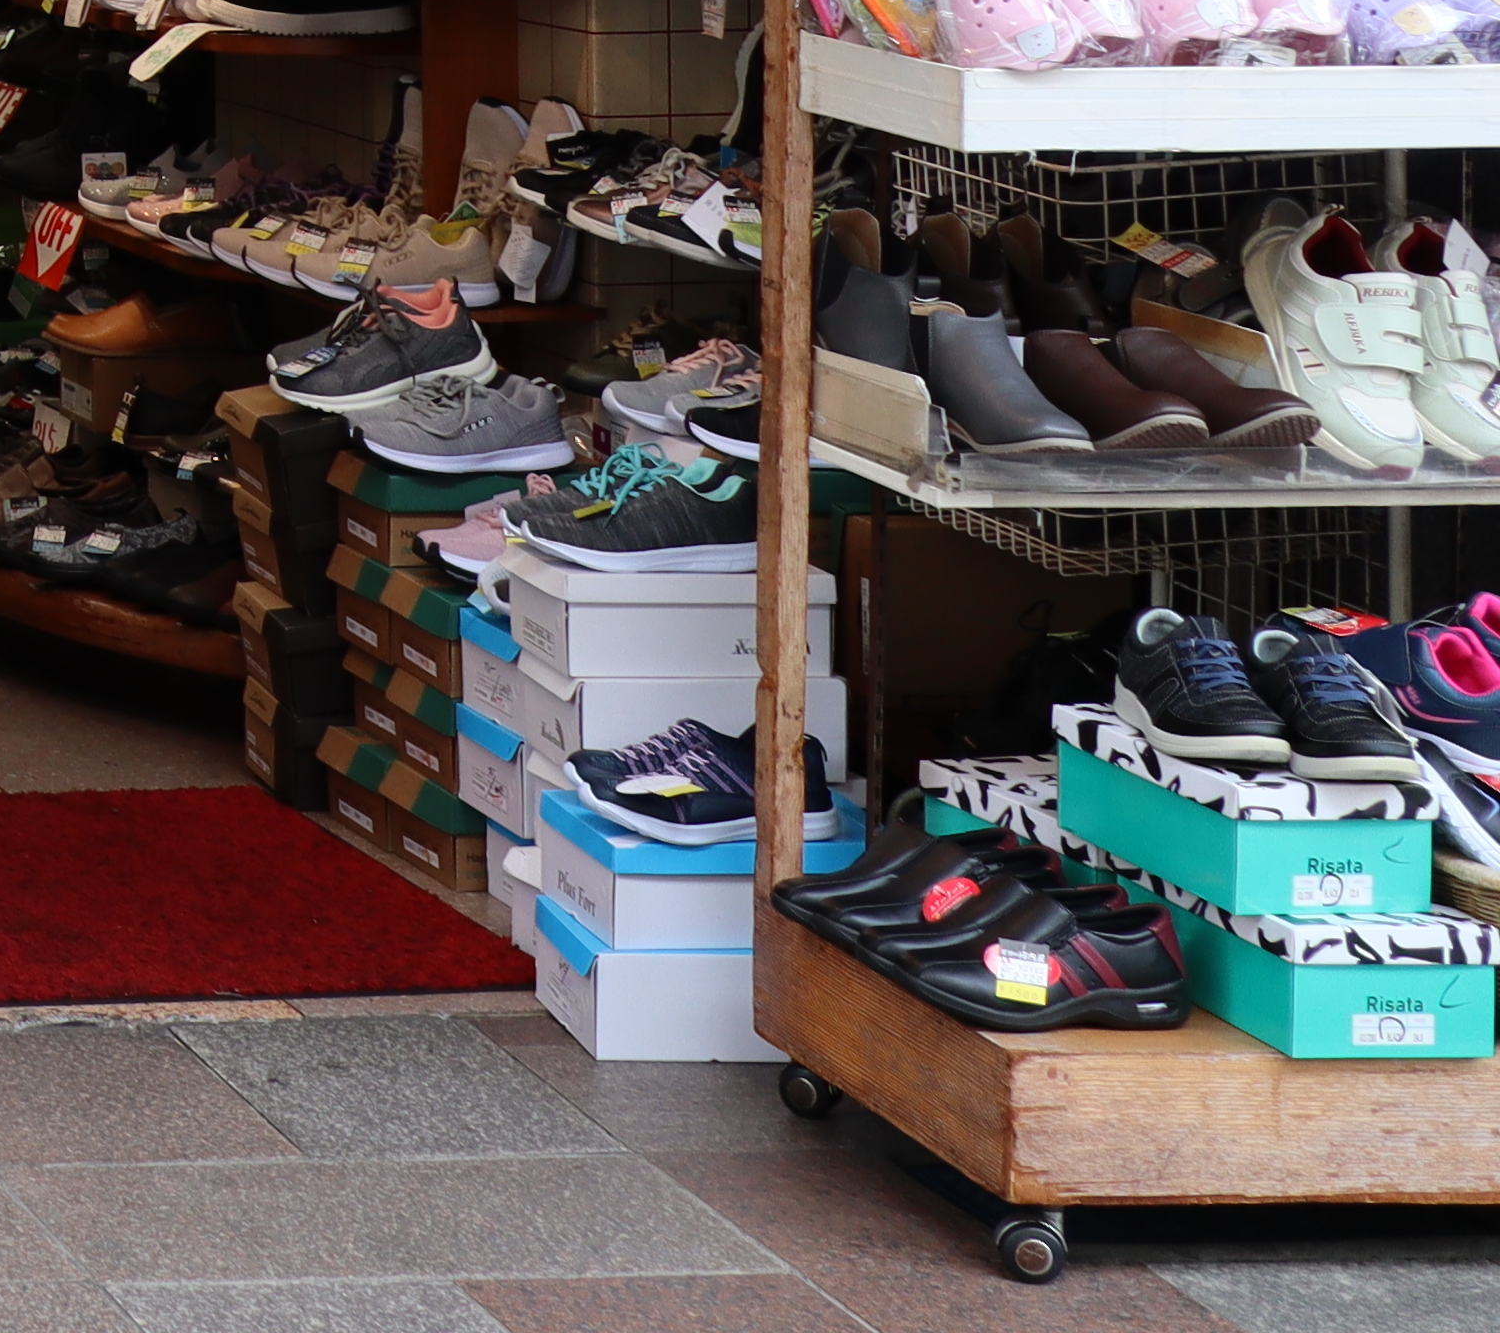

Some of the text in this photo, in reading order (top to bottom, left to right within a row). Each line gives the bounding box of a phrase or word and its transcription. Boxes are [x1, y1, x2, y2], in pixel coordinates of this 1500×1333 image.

[1362, 286, 1411, 298] REBIKA
[1307, 857, 1364, 874] Risata
[557, 869, 598, 918] Plus Fort
[1366, 995, 1424, 1013] Risata
